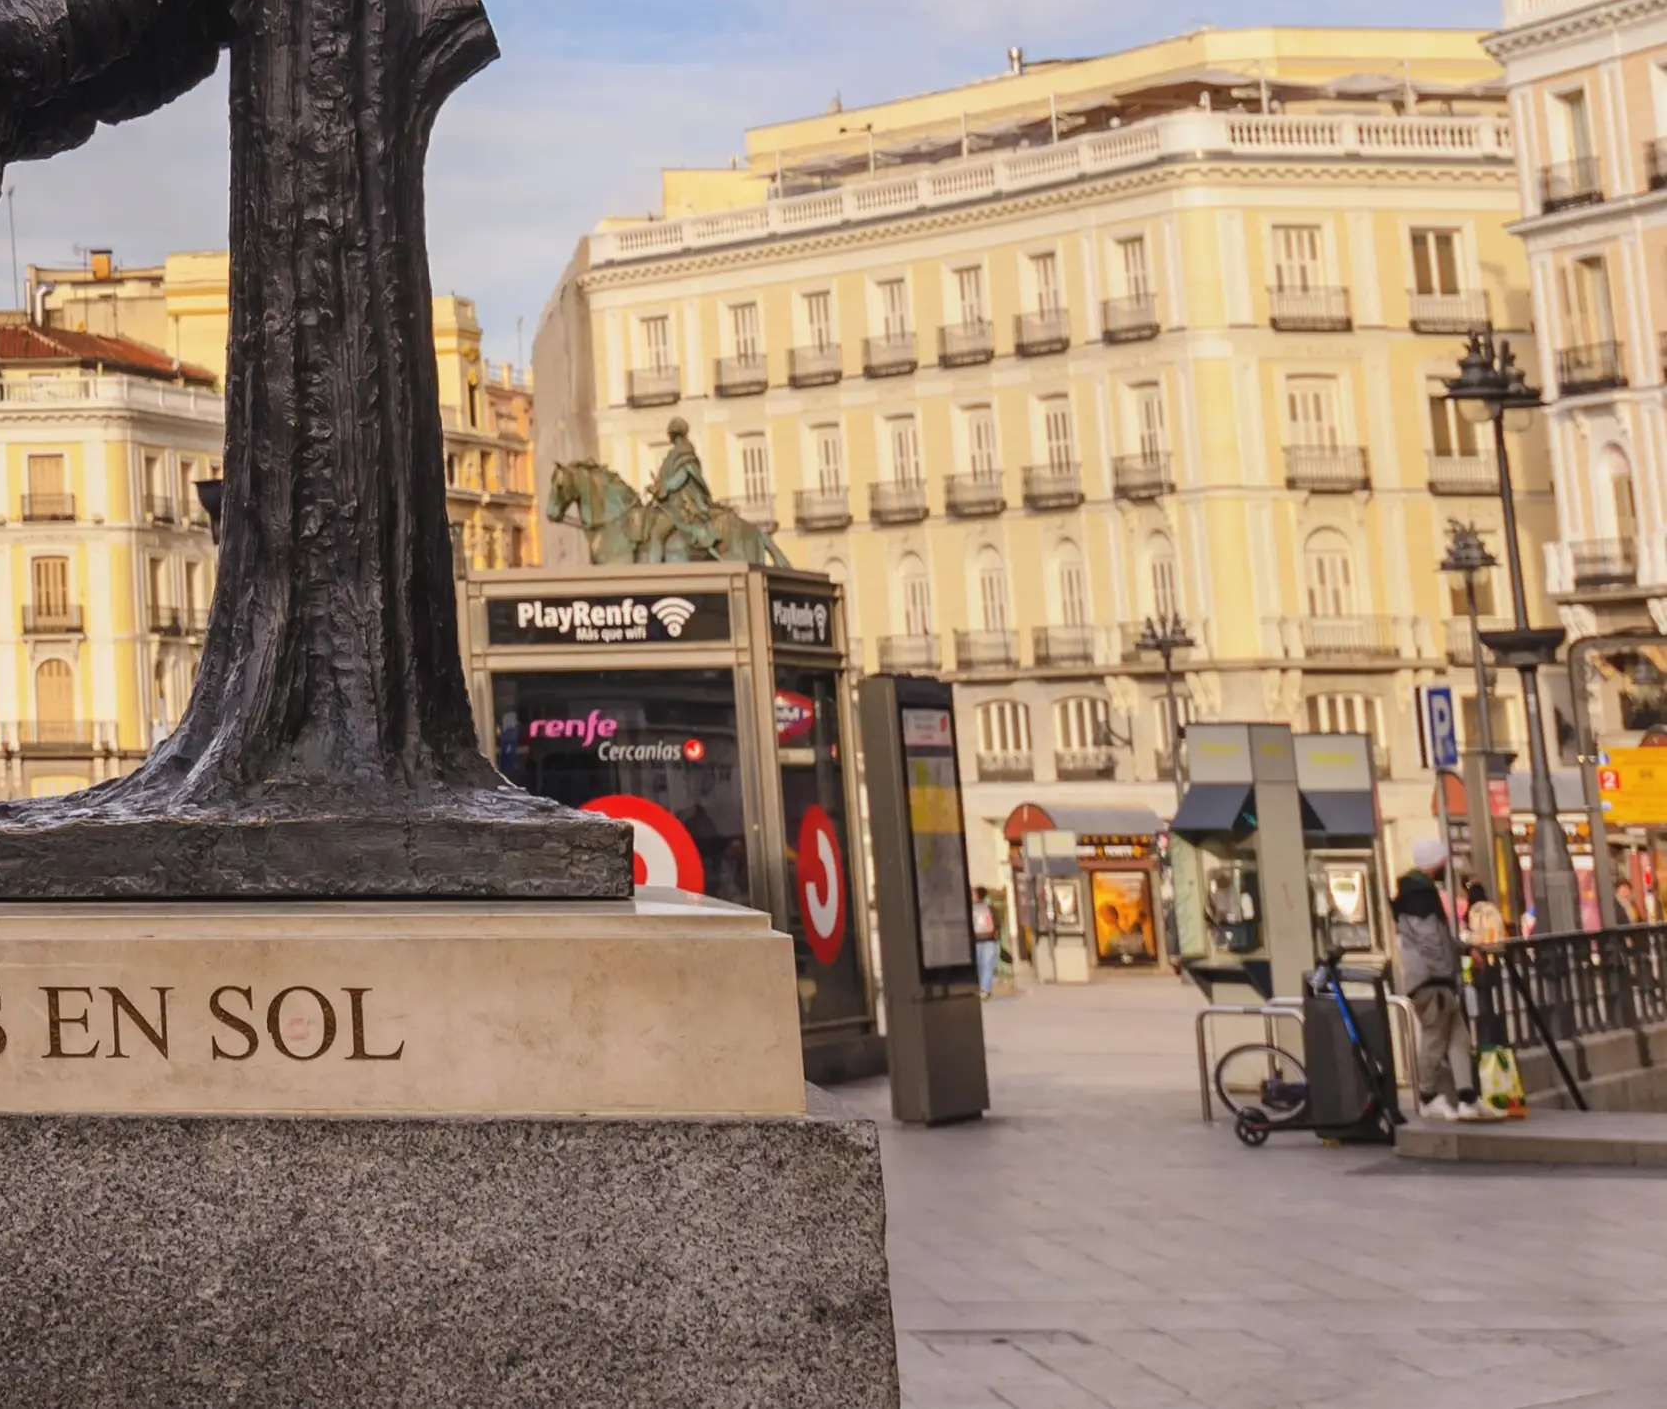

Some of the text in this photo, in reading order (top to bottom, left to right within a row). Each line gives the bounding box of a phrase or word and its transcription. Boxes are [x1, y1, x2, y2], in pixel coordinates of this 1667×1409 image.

[517, 598, 649, 633] PlayRenfe
[576, 625, 647, 642] Más que wifi
[529, 709, 617, 748] renfe
[1432, 695, 1451, 764] P
[598, 740, 681, 762] Cercanías
[1602, 771, 1616, 789] 2
[41, 986, 170, 1061] EN
[209, 985, 406, 1061] SOL
